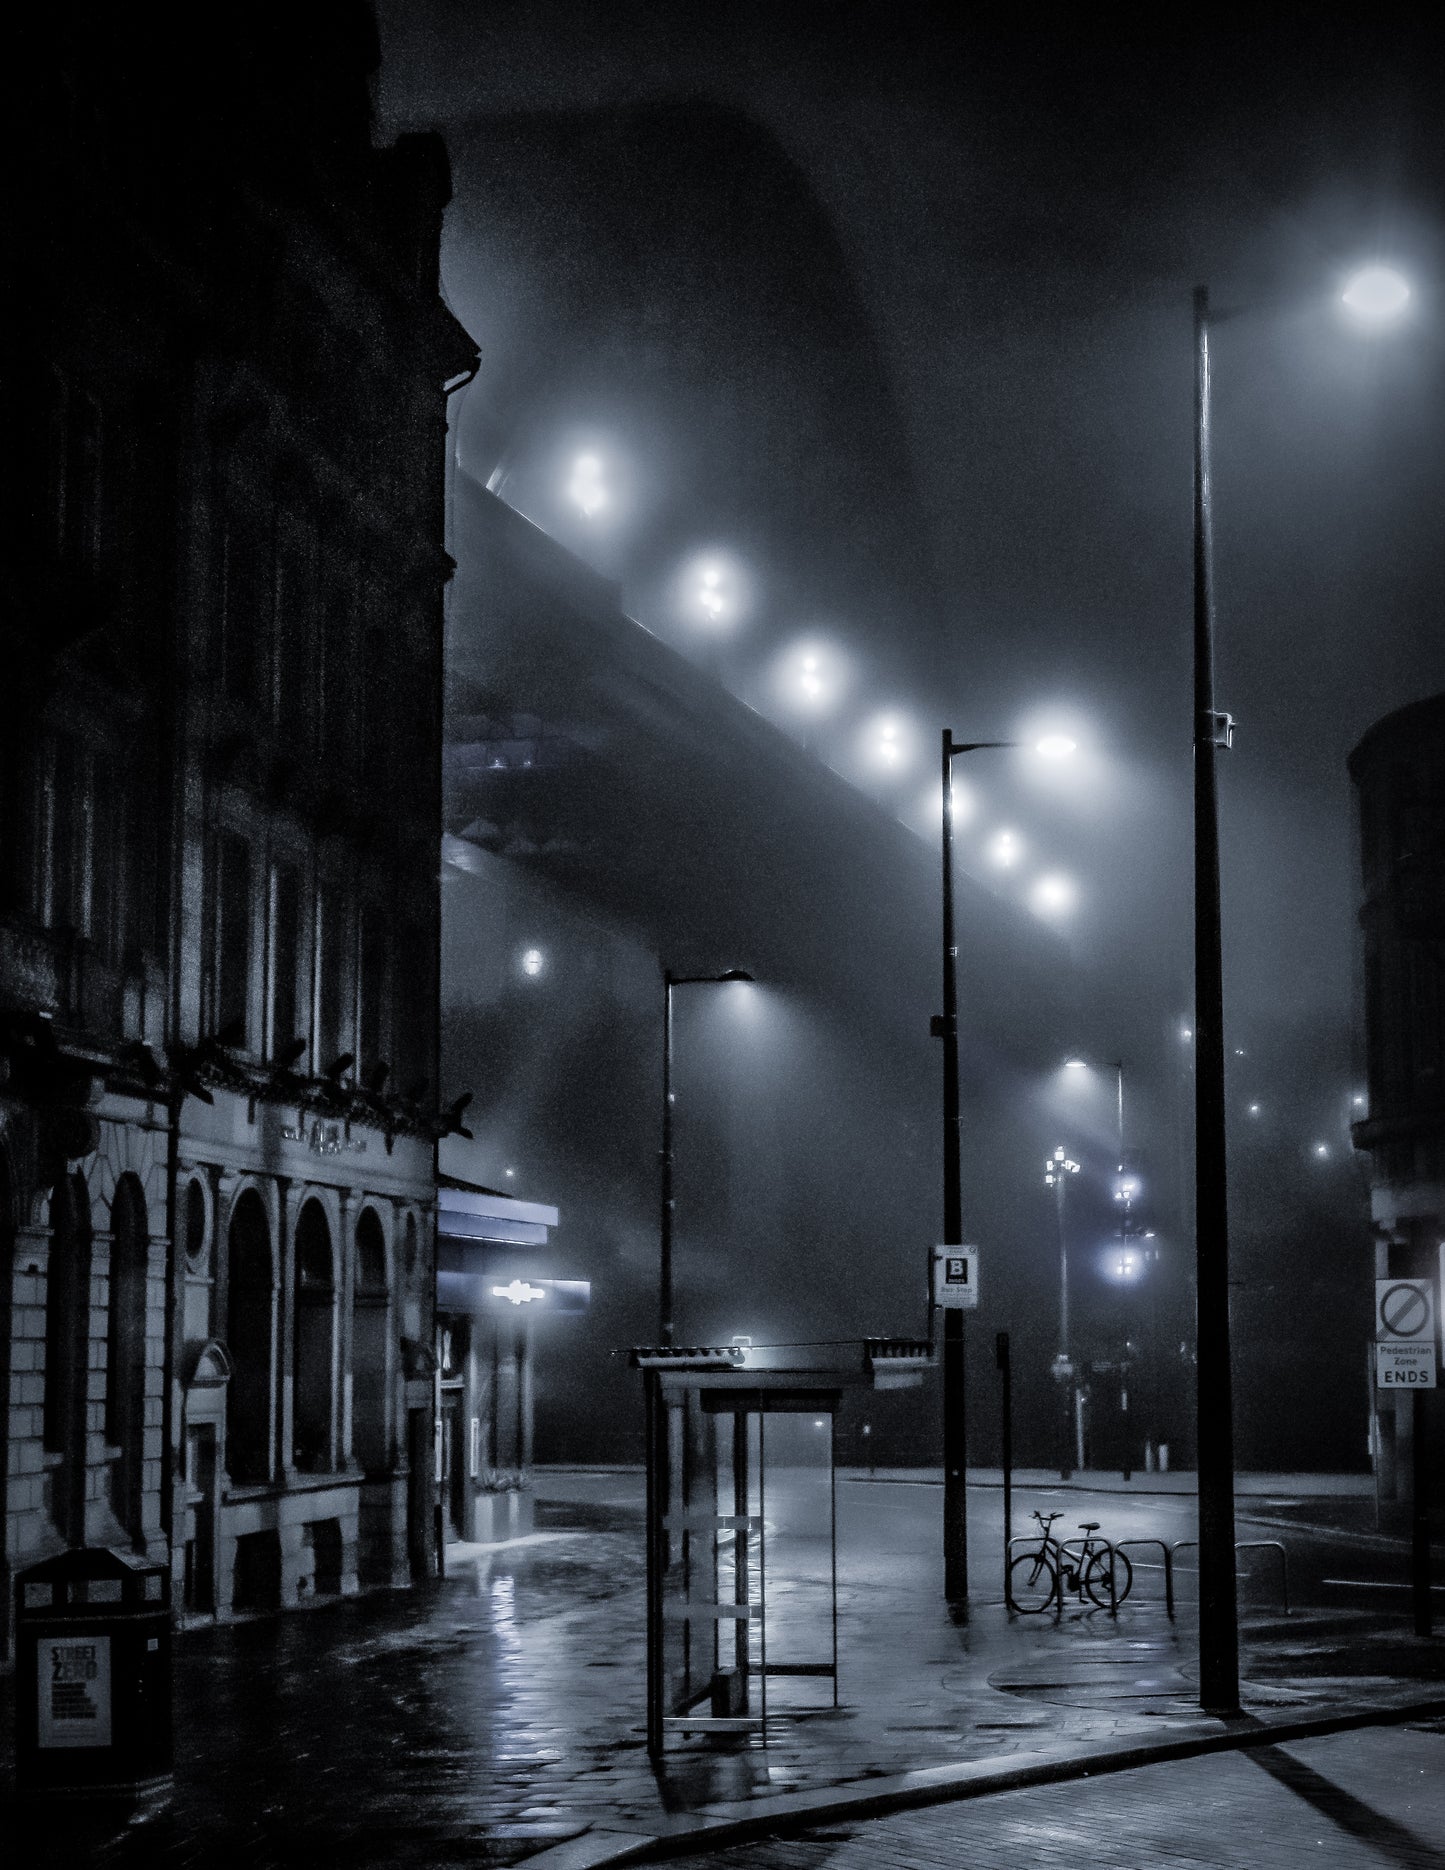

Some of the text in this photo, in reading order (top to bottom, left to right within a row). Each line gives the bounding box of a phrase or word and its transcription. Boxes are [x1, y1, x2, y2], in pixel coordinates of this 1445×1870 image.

[1380, 1346, 1432, 1355] Pedestrian
[1394, 1357, 1418, 1366] Zone
[1384, 1370, 1429, 1383] ENDS
